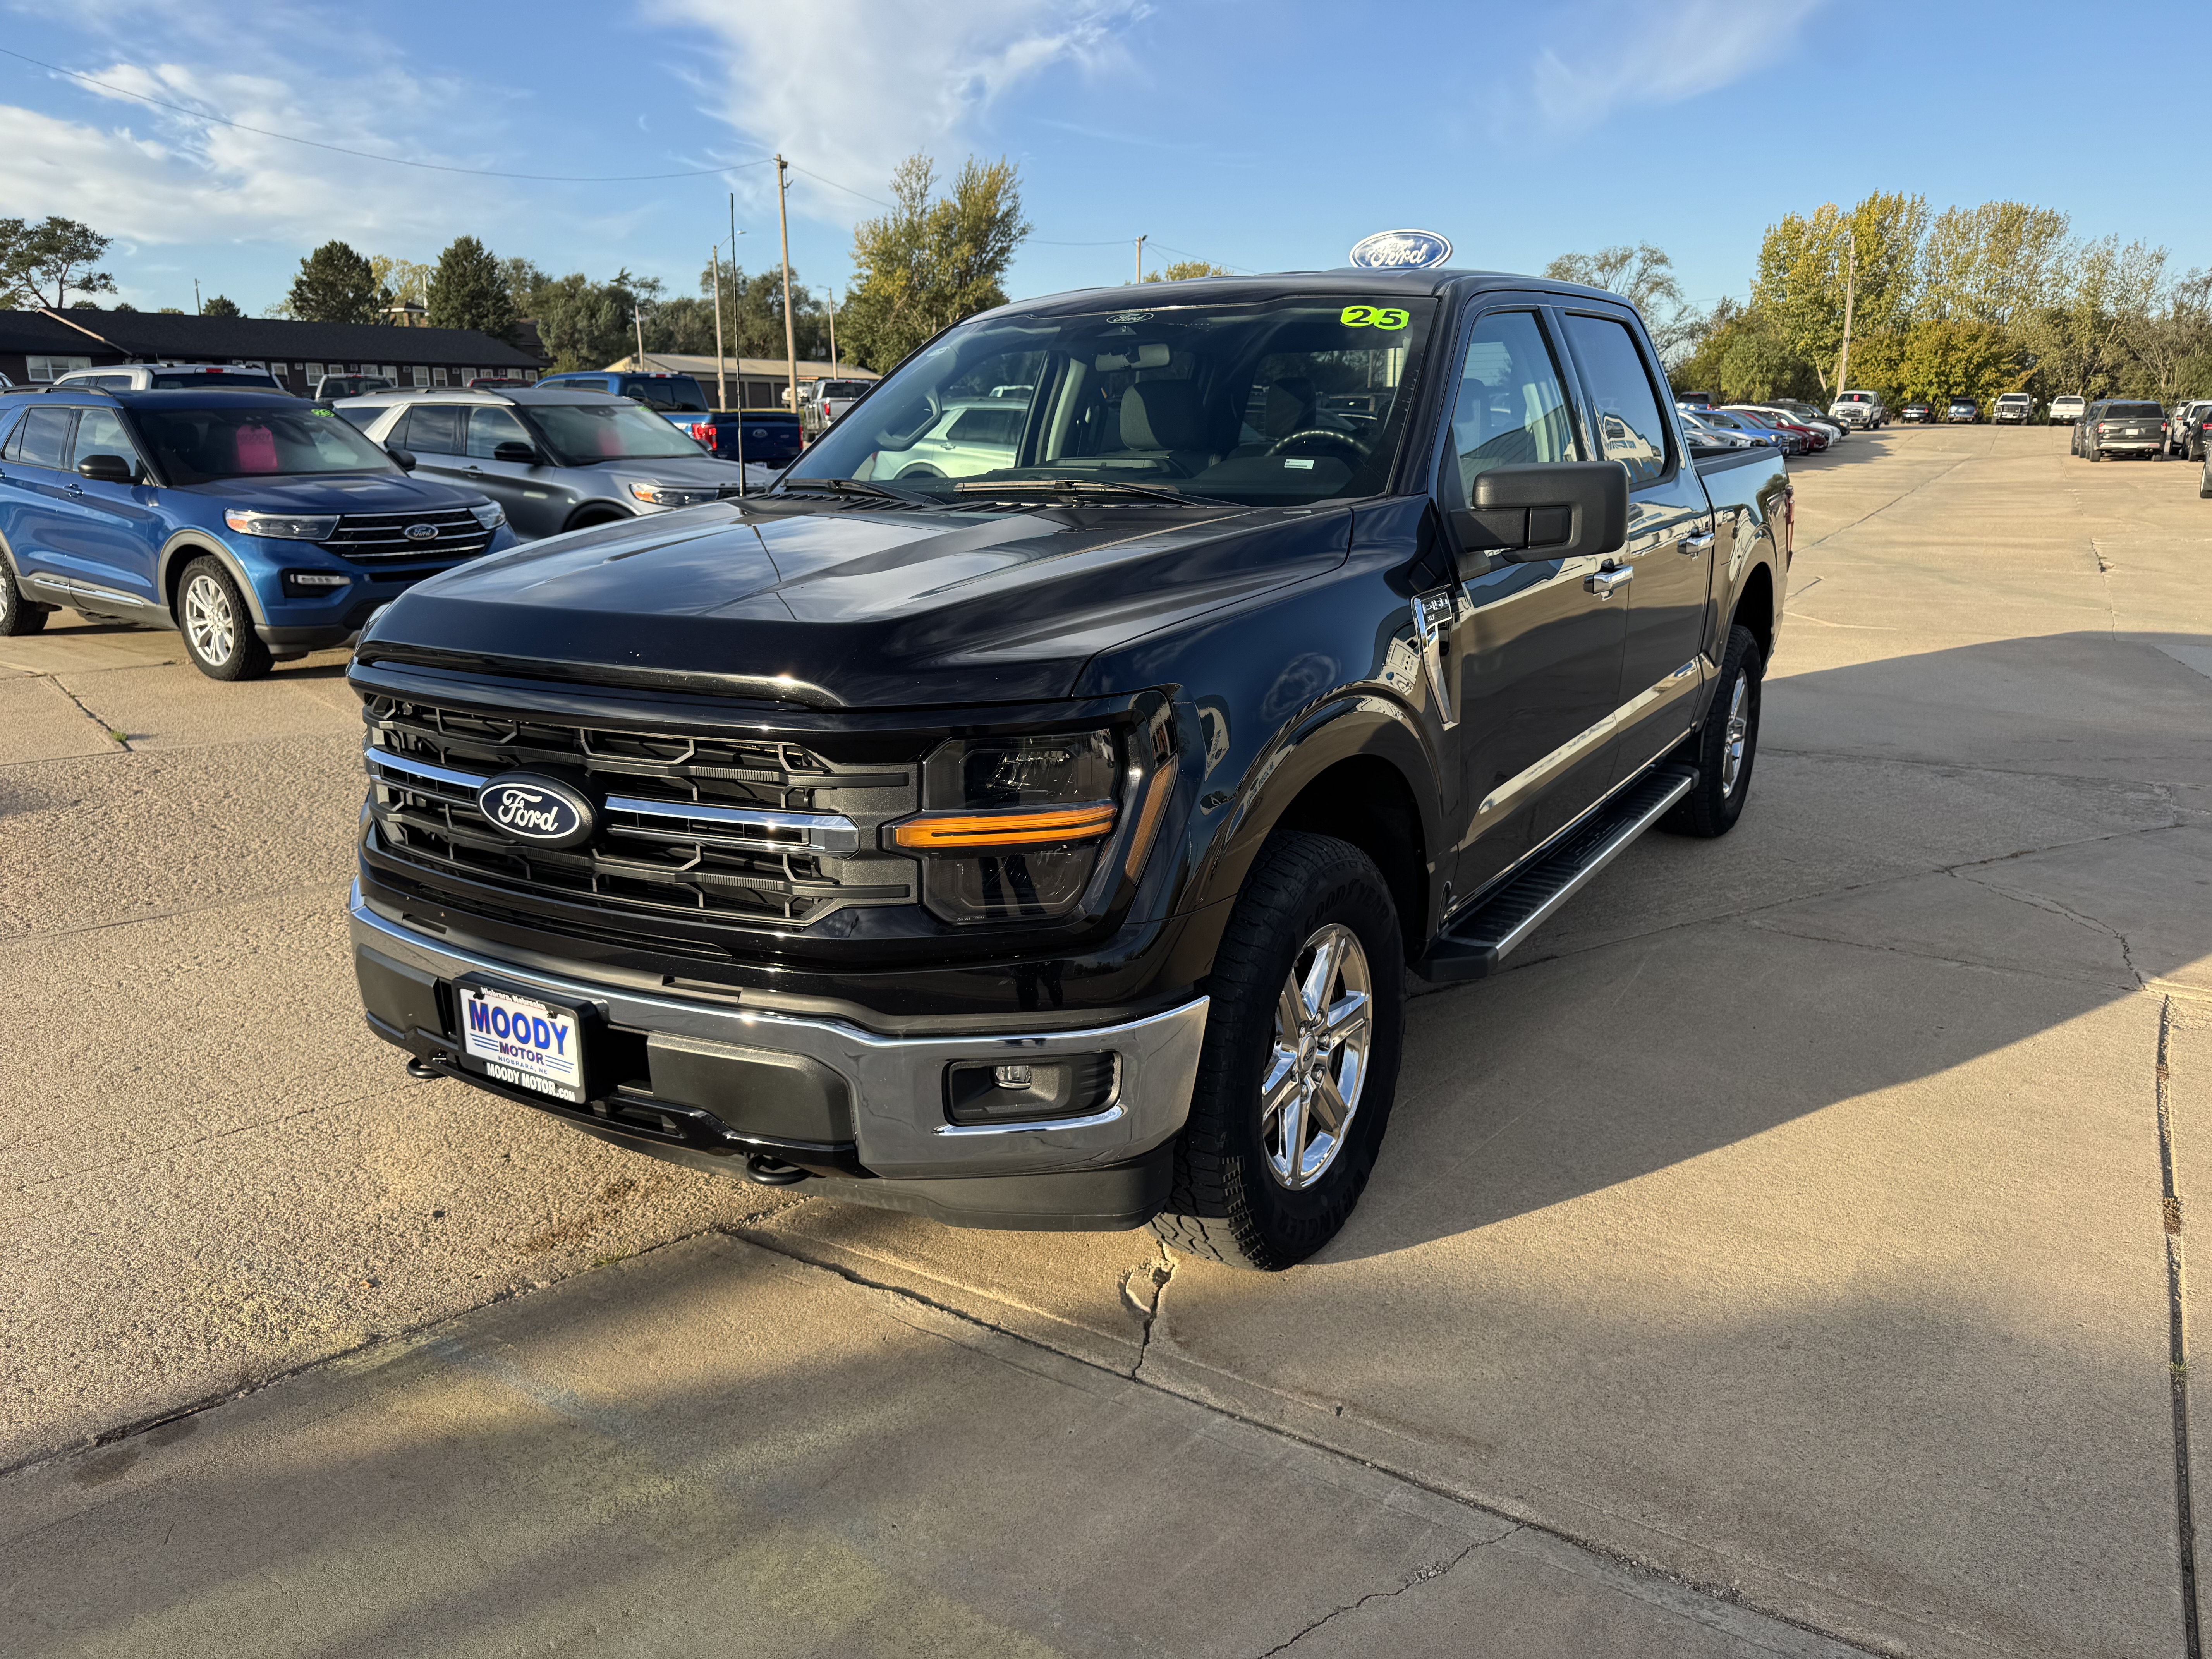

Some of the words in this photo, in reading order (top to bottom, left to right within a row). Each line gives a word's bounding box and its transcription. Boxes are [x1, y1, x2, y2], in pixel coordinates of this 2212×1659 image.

[1369, 237, 1429, 267] Ford
[1346, 308, 1402, 326] 25
[413, 527, 431, 537] Ford
[498, 790, 558, 831] Ford
[481, 987, 512, 1001] Niobrara,
[512, 994, 546, 1010] Nebraska
[468, 999, 569, 1055] MOODY
[498, 1056, 536, 1072] NIOBRARA,
[499, 1042, 545, 1065] MOTOR
[487, 1062, 520, 1084] MOODY
